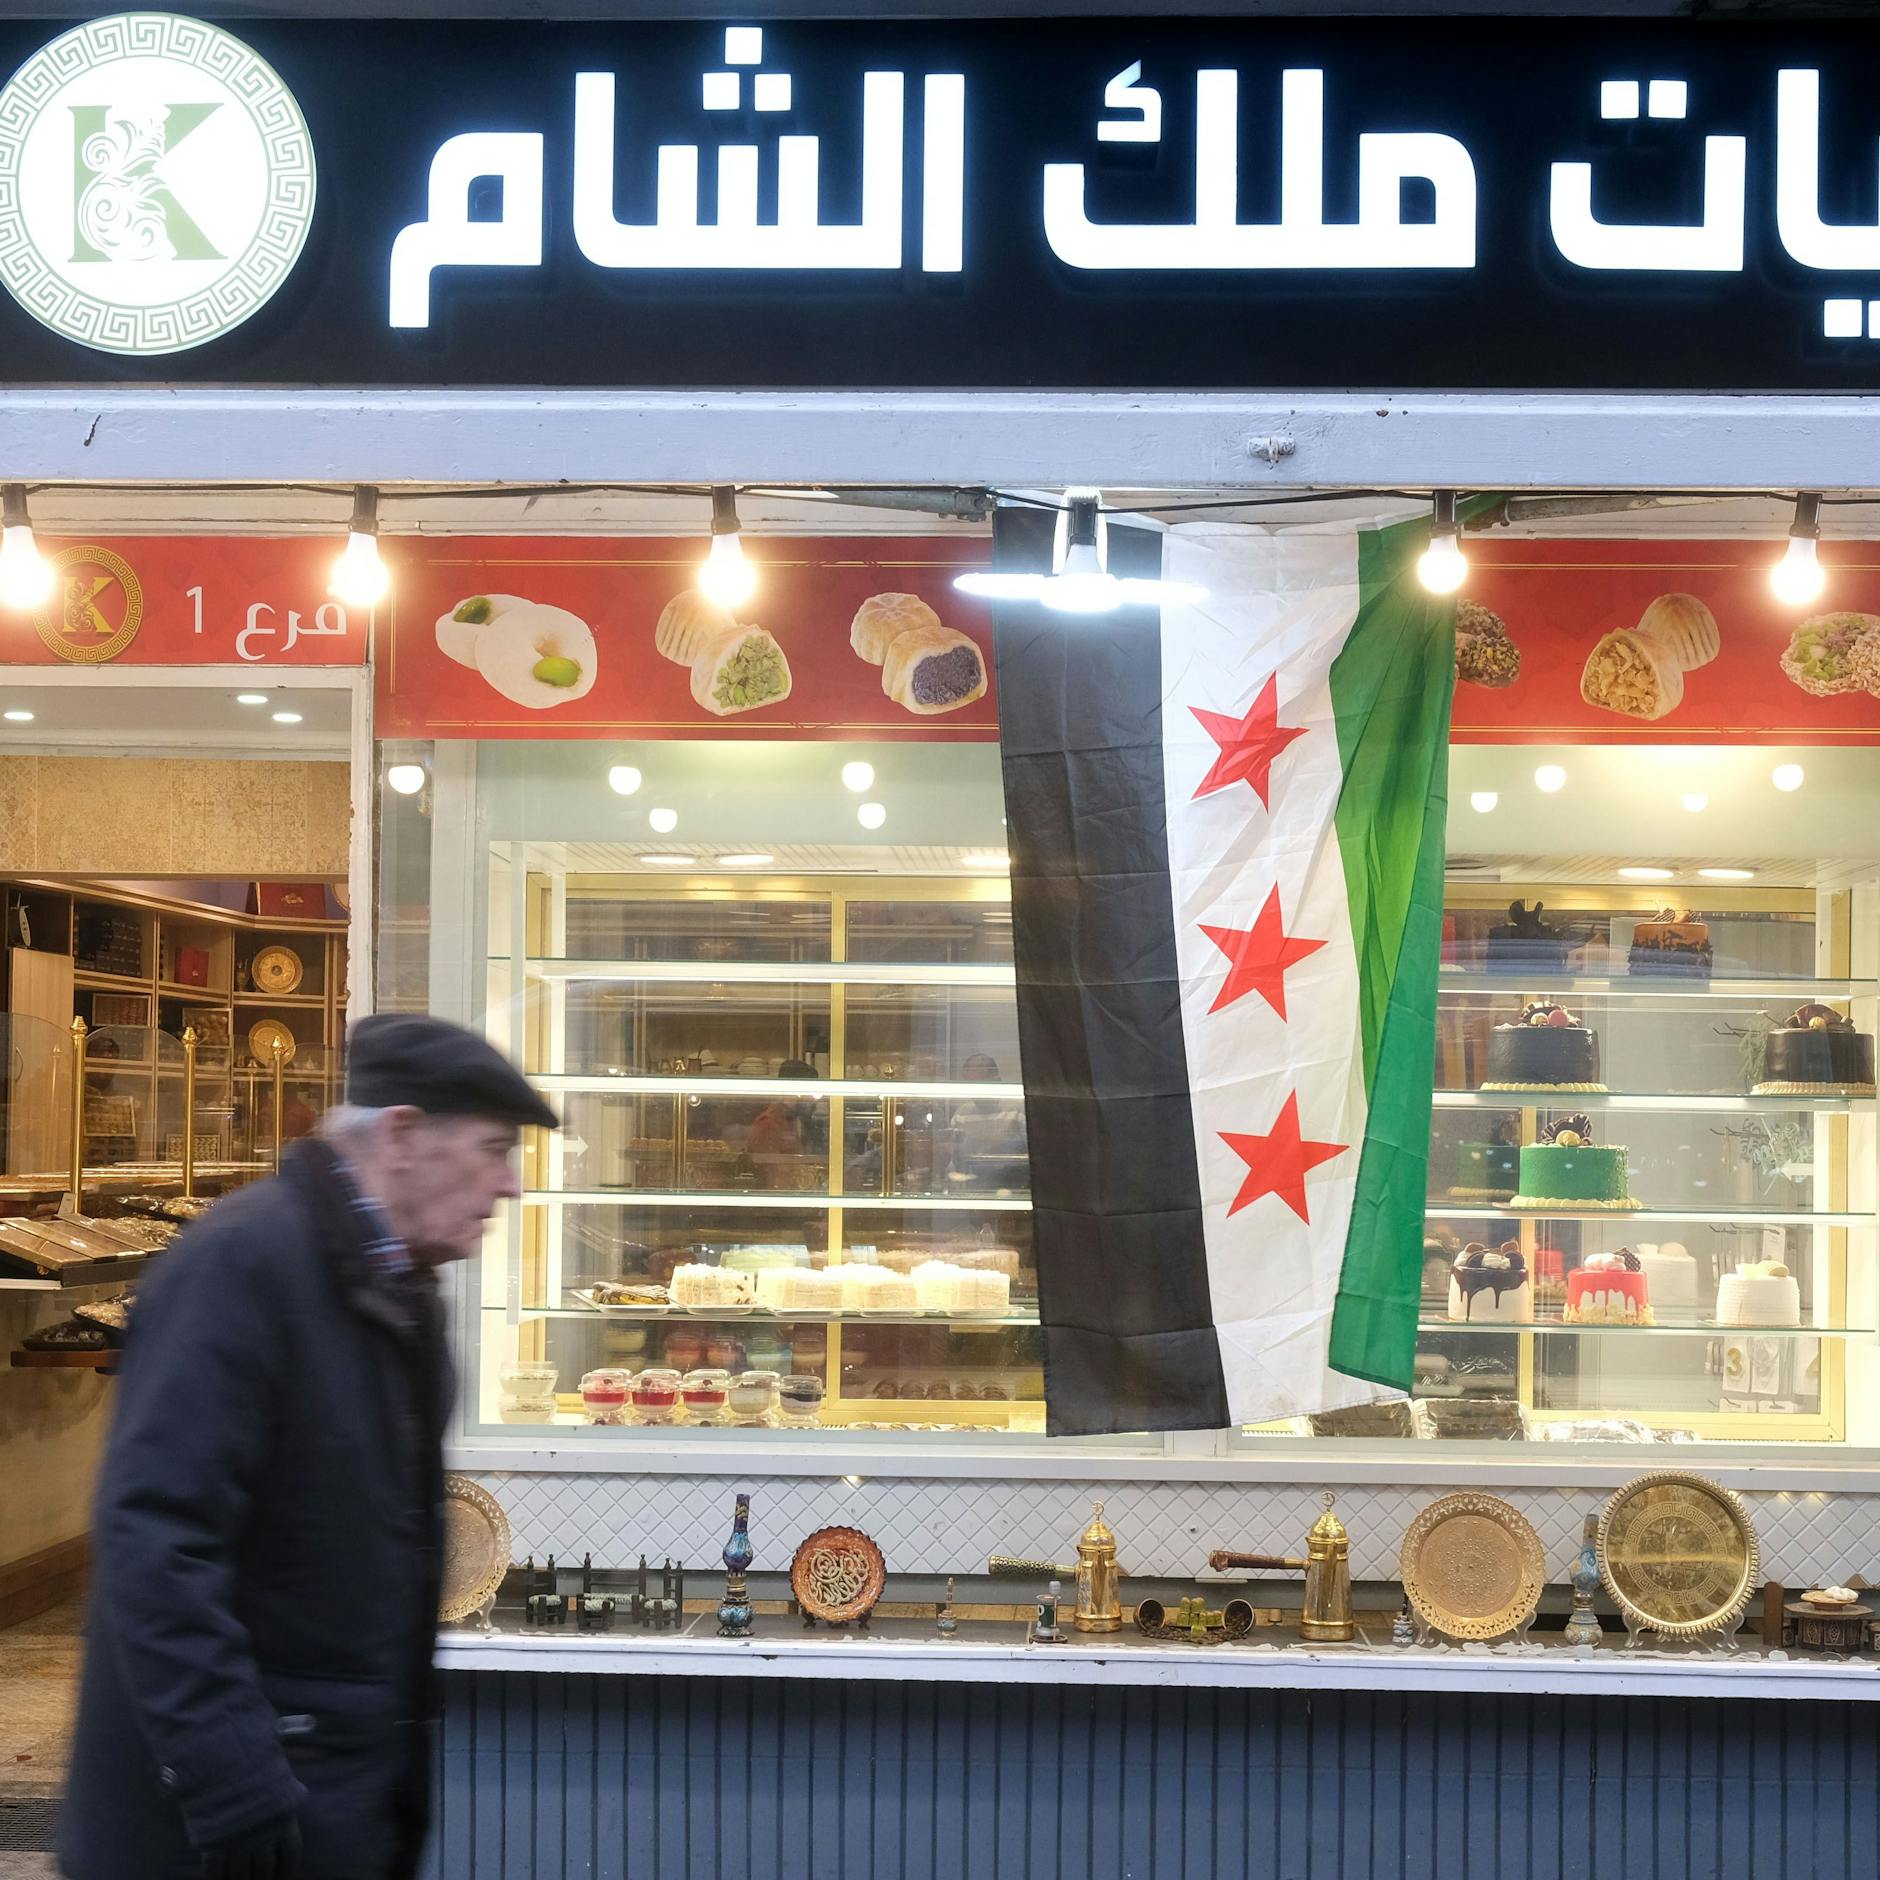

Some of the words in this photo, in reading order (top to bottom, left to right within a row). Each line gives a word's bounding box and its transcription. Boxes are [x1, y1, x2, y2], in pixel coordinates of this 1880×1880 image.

[390, 27, 964, 327] الشام
[1044, 63, 1476, 269] ملك
[186, 586, 203, 633] 1
[235, 585, 347, 661] فرع
[1727, 1347, 1743, 1377] 3
